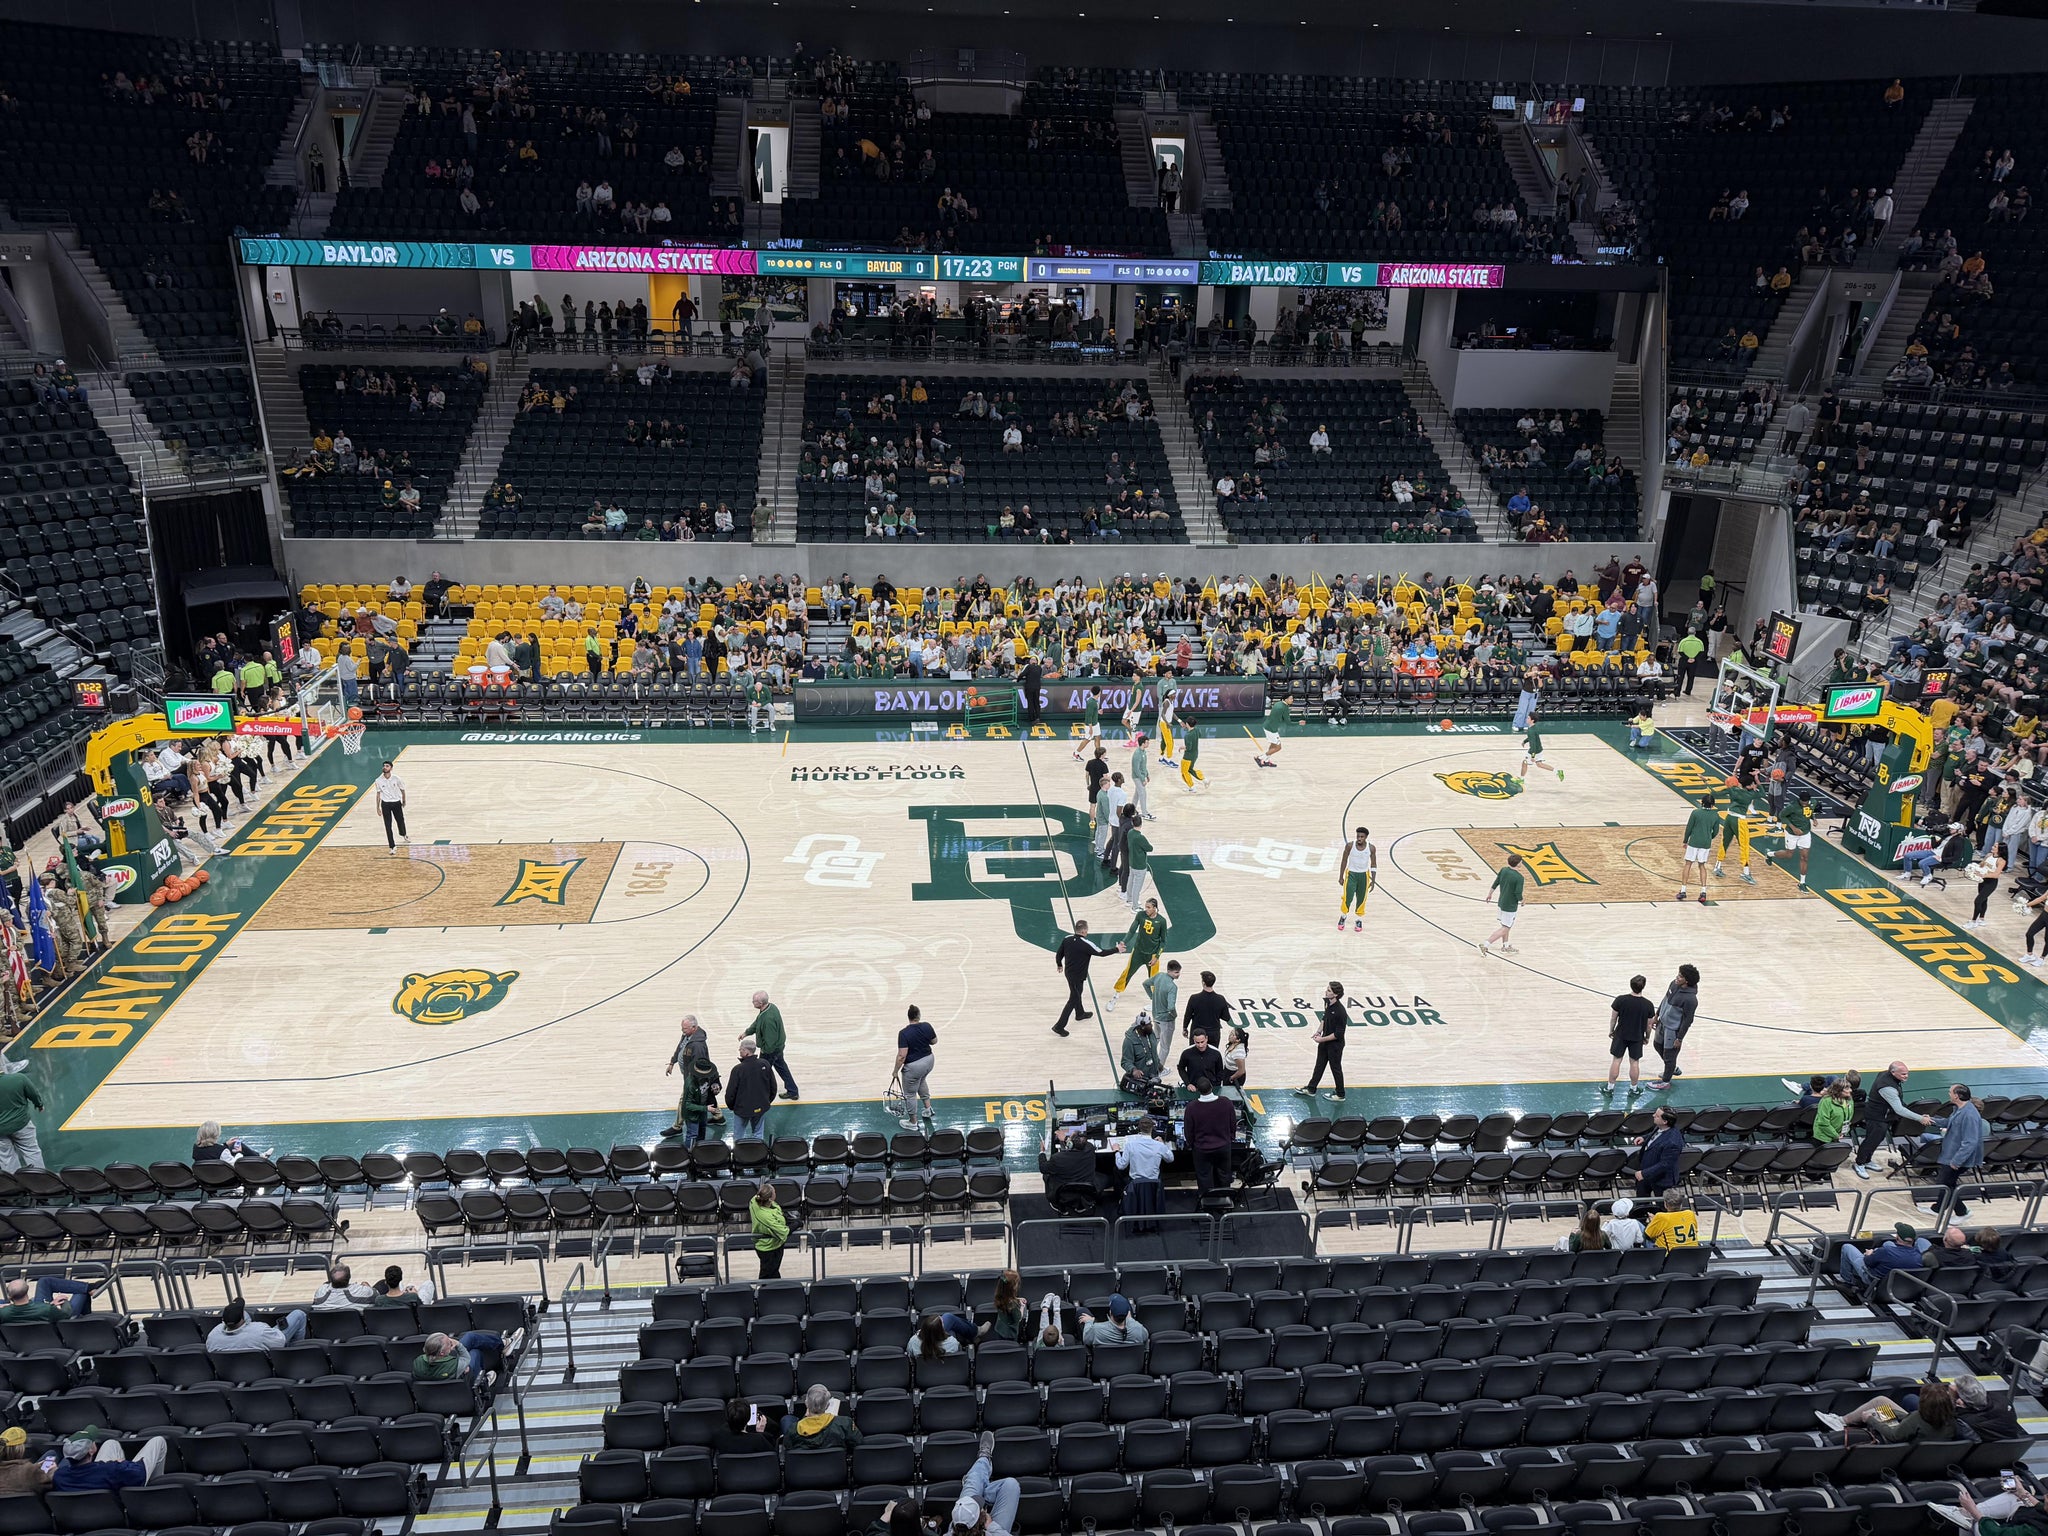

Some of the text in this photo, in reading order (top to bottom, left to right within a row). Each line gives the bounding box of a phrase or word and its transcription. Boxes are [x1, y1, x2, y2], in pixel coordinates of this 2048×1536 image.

[323, 245, 515, 265] BAYLOR VS
[575, 249, 714, 271] ARIZONA STATE
[836, 260, 842, 270] 0
[867, 261, 924, 273] BAYLOR 0
[943, 259, 1018, 278] 17:23 PGM
[1038, 265, 1046, 276] 0
[1134, 266, 1140, 277] 0
[1146, 268, 1155, 276] TO
[1231, 265, 1362, 283] BAYLOR VS
[1390, 268, 1489, 285] ARIZONA STATE
[280, 637, 294, 663] 30
[1772, 633, 1790, 658] 30
[77, 683, 102, 692] 17:22
[1926, 682, 1941, 693] 30
[83, 693, 99, 706] 30
[1834, 690, 1873, 712] LIBMAN
[174, 704, 219, 724] LIBMAN
[1780, 712, 1812, 720] StateFarm
[253, 725, 293, 734] StateFarm
[460, 732, 641, 742] @BaylorAthletics
[791, 771, 966, 781] HURD FLOOR
[1889, 778, 1920, 794] LIBMAN
[102, 800, 135, 818] LIBMAN
[229, 784, 358, 856] BEARS
[1421, 848, 1482, 881] 1845
[624, 861, 674, 898] 1845
[909, 804, 1216, 953] BU
[1825, 888, 2020, 985] BEARS
[30, 912, 241, 1049] BAYLOR
[1293, 998, 1314, 1009] &
[1347, 996, 1432, 1008] AULA
[1226, 1012, 1308, 1028] URD
[1673, 1223, 1697, 1244] 54
